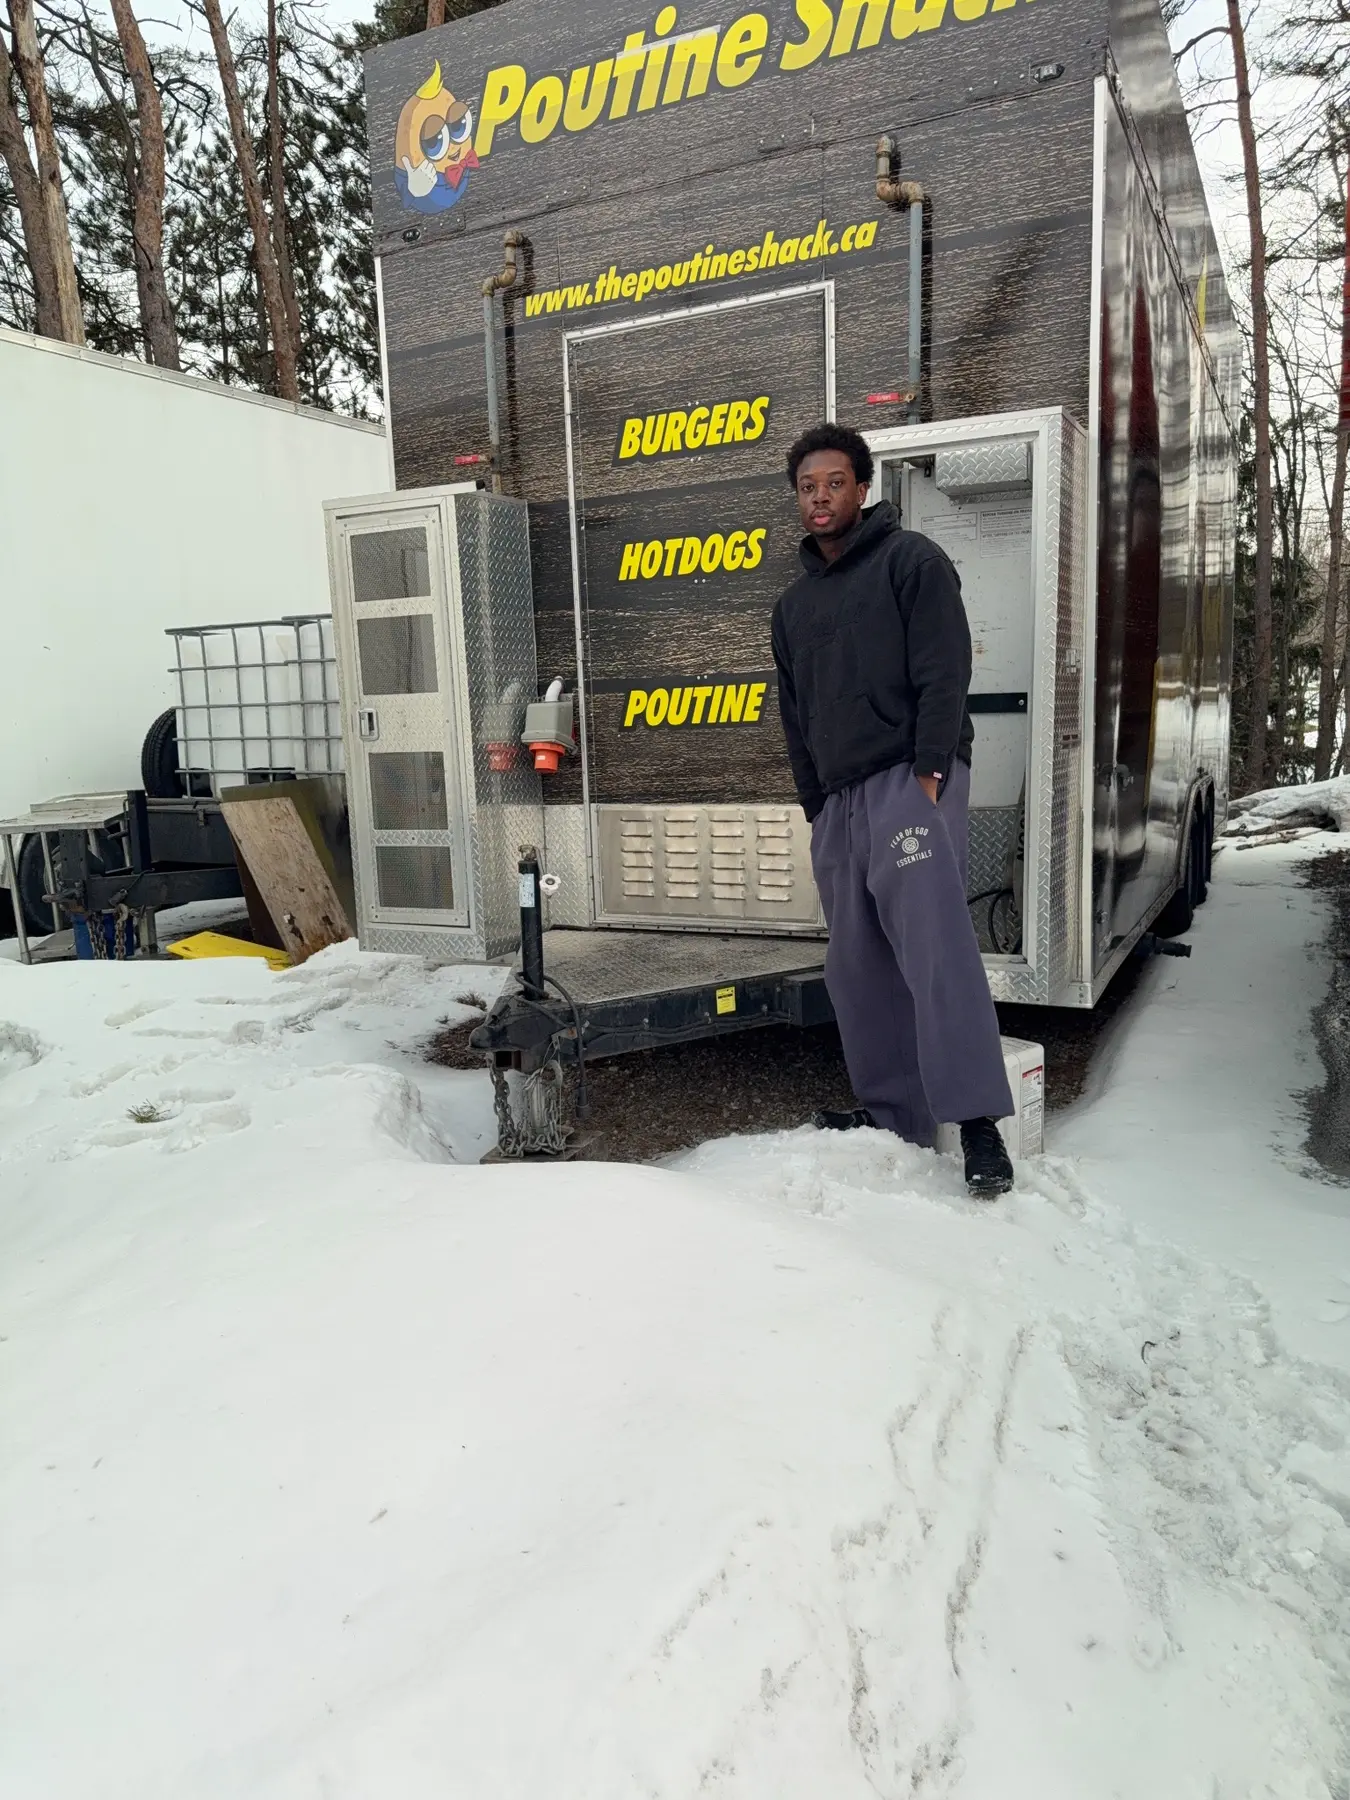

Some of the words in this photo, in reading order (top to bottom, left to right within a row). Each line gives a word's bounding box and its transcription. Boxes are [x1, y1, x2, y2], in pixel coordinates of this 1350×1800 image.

[473, 5, 769, 158] Poutine
[524, 219, 879, 317] www.thepoutineshack.ca
[618, 396, 770, 460] BURGERS
[618, 528, 767, 581] HOTDOGS
[623, 682, 767, 728] POUTINE
[904, 827, 913, 837] OF
[915, 826, 929, 836] GOD
[896, 849, 932, 868] ESSENTIALS
